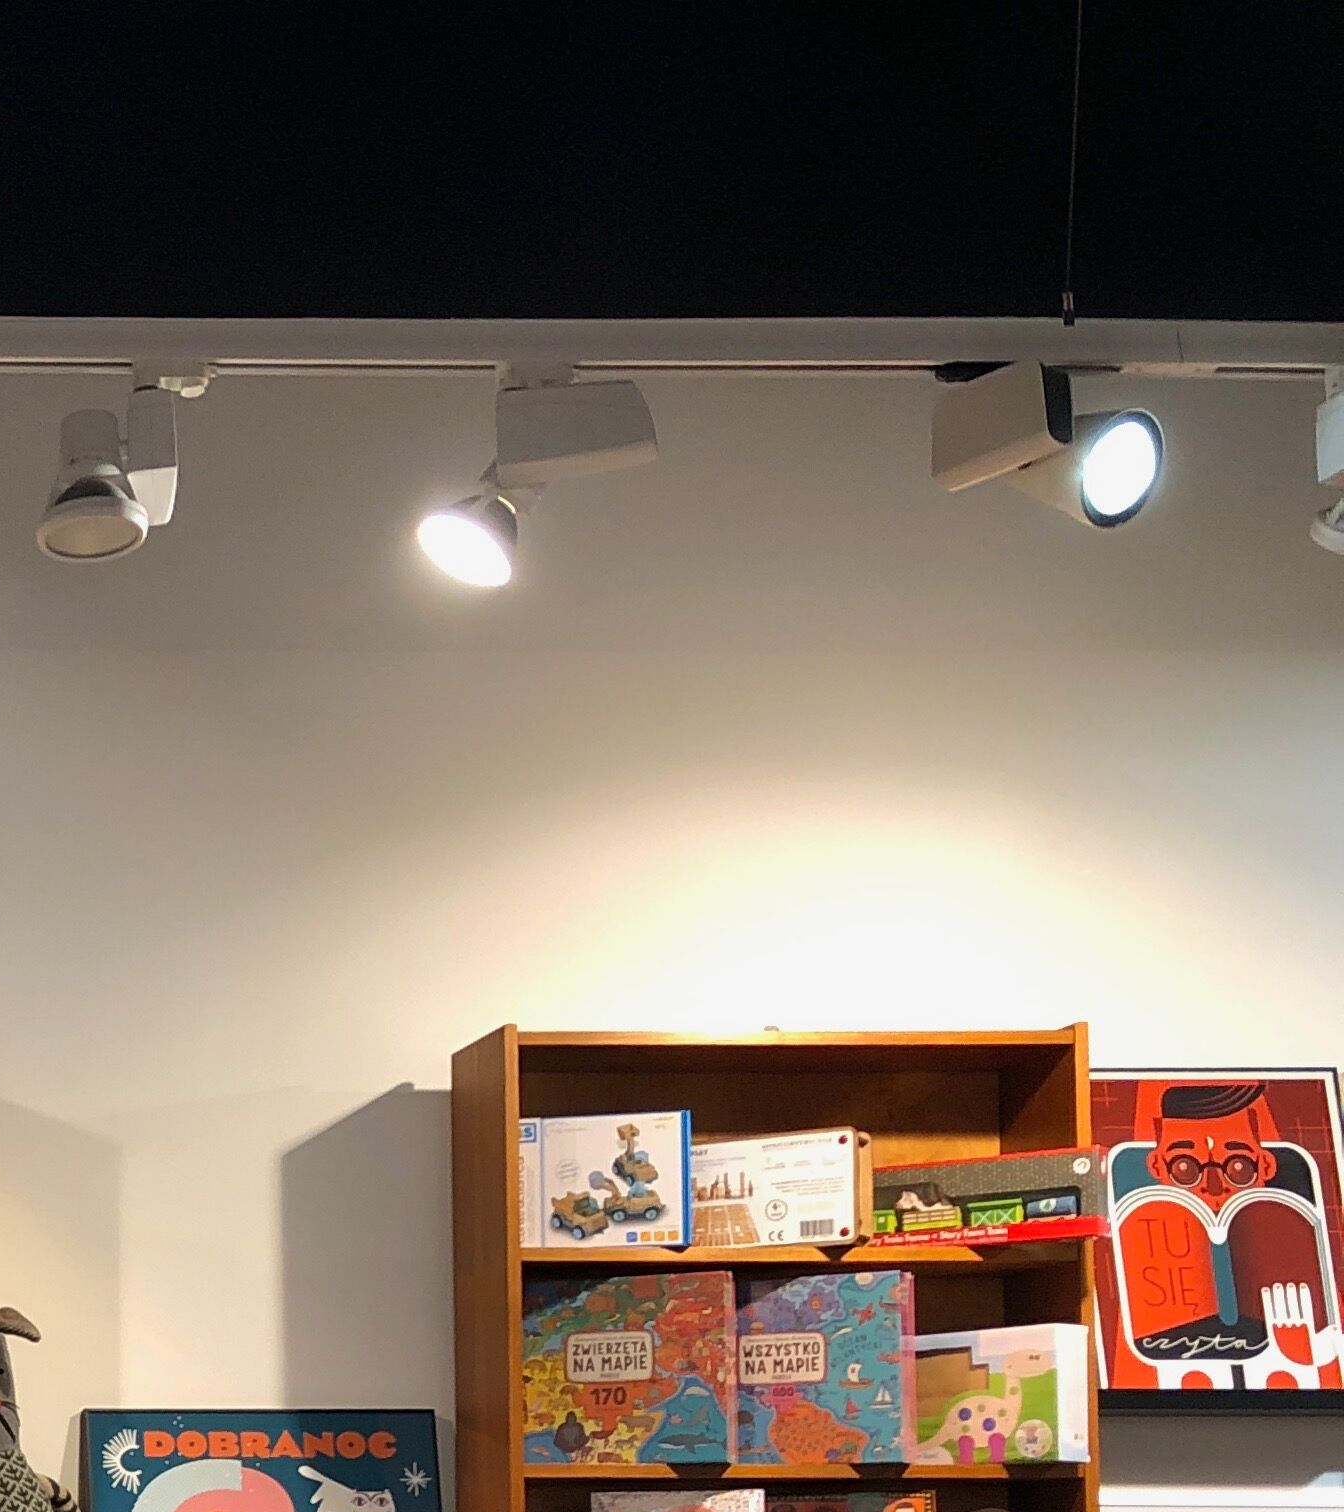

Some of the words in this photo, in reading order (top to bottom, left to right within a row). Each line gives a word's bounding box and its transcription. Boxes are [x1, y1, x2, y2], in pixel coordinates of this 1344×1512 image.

[1138, 1219, 1191, 1258] TU
[1141, 1266, 1200, 1317] SIĘ
[571, 1341, 647, 1358] ZWIERZĘTA
[741, 1342, 821, 1358] WSZYSTKO
[1141, 1329, 1271, 1358] czyta
[573, 1358, 594, 1372] NA
[601, 1356, 647, 1371] MAPIE
[745, 1360, 765, 1374] NA
[772, 1358, 820, 1373] MAPIE
[590, 1387, 626, 1406] 170
[143, 1429, 398, 1458] DOBRANOC
